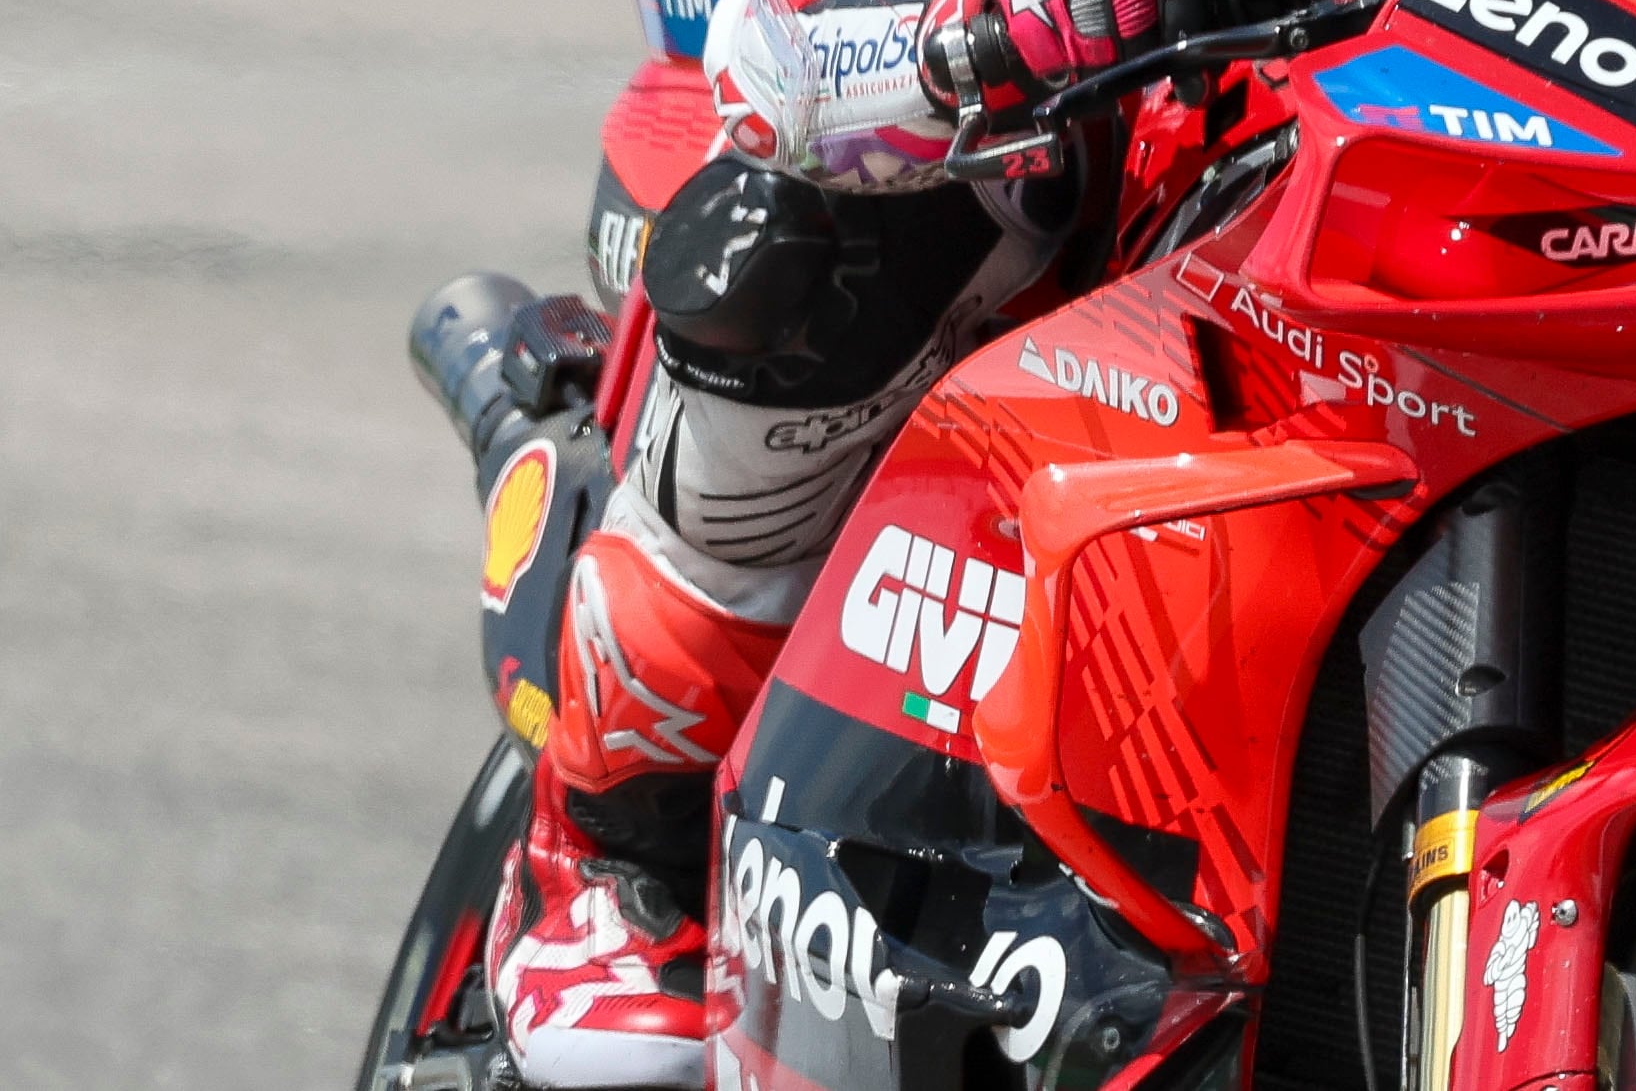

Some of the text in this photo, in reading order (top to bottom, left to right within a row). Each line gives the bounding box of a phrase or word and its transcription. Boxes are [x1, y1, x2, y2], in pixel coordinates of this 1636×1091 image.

[1002, 147, 1051, 179] 23
[1429, 105, 1553, 148] TIM
[1054, 346, 1180, 428] DAIKO
[1230, 286, 1478, 439] Audi Sport
[840, 523, 1027, 702] GIVI
